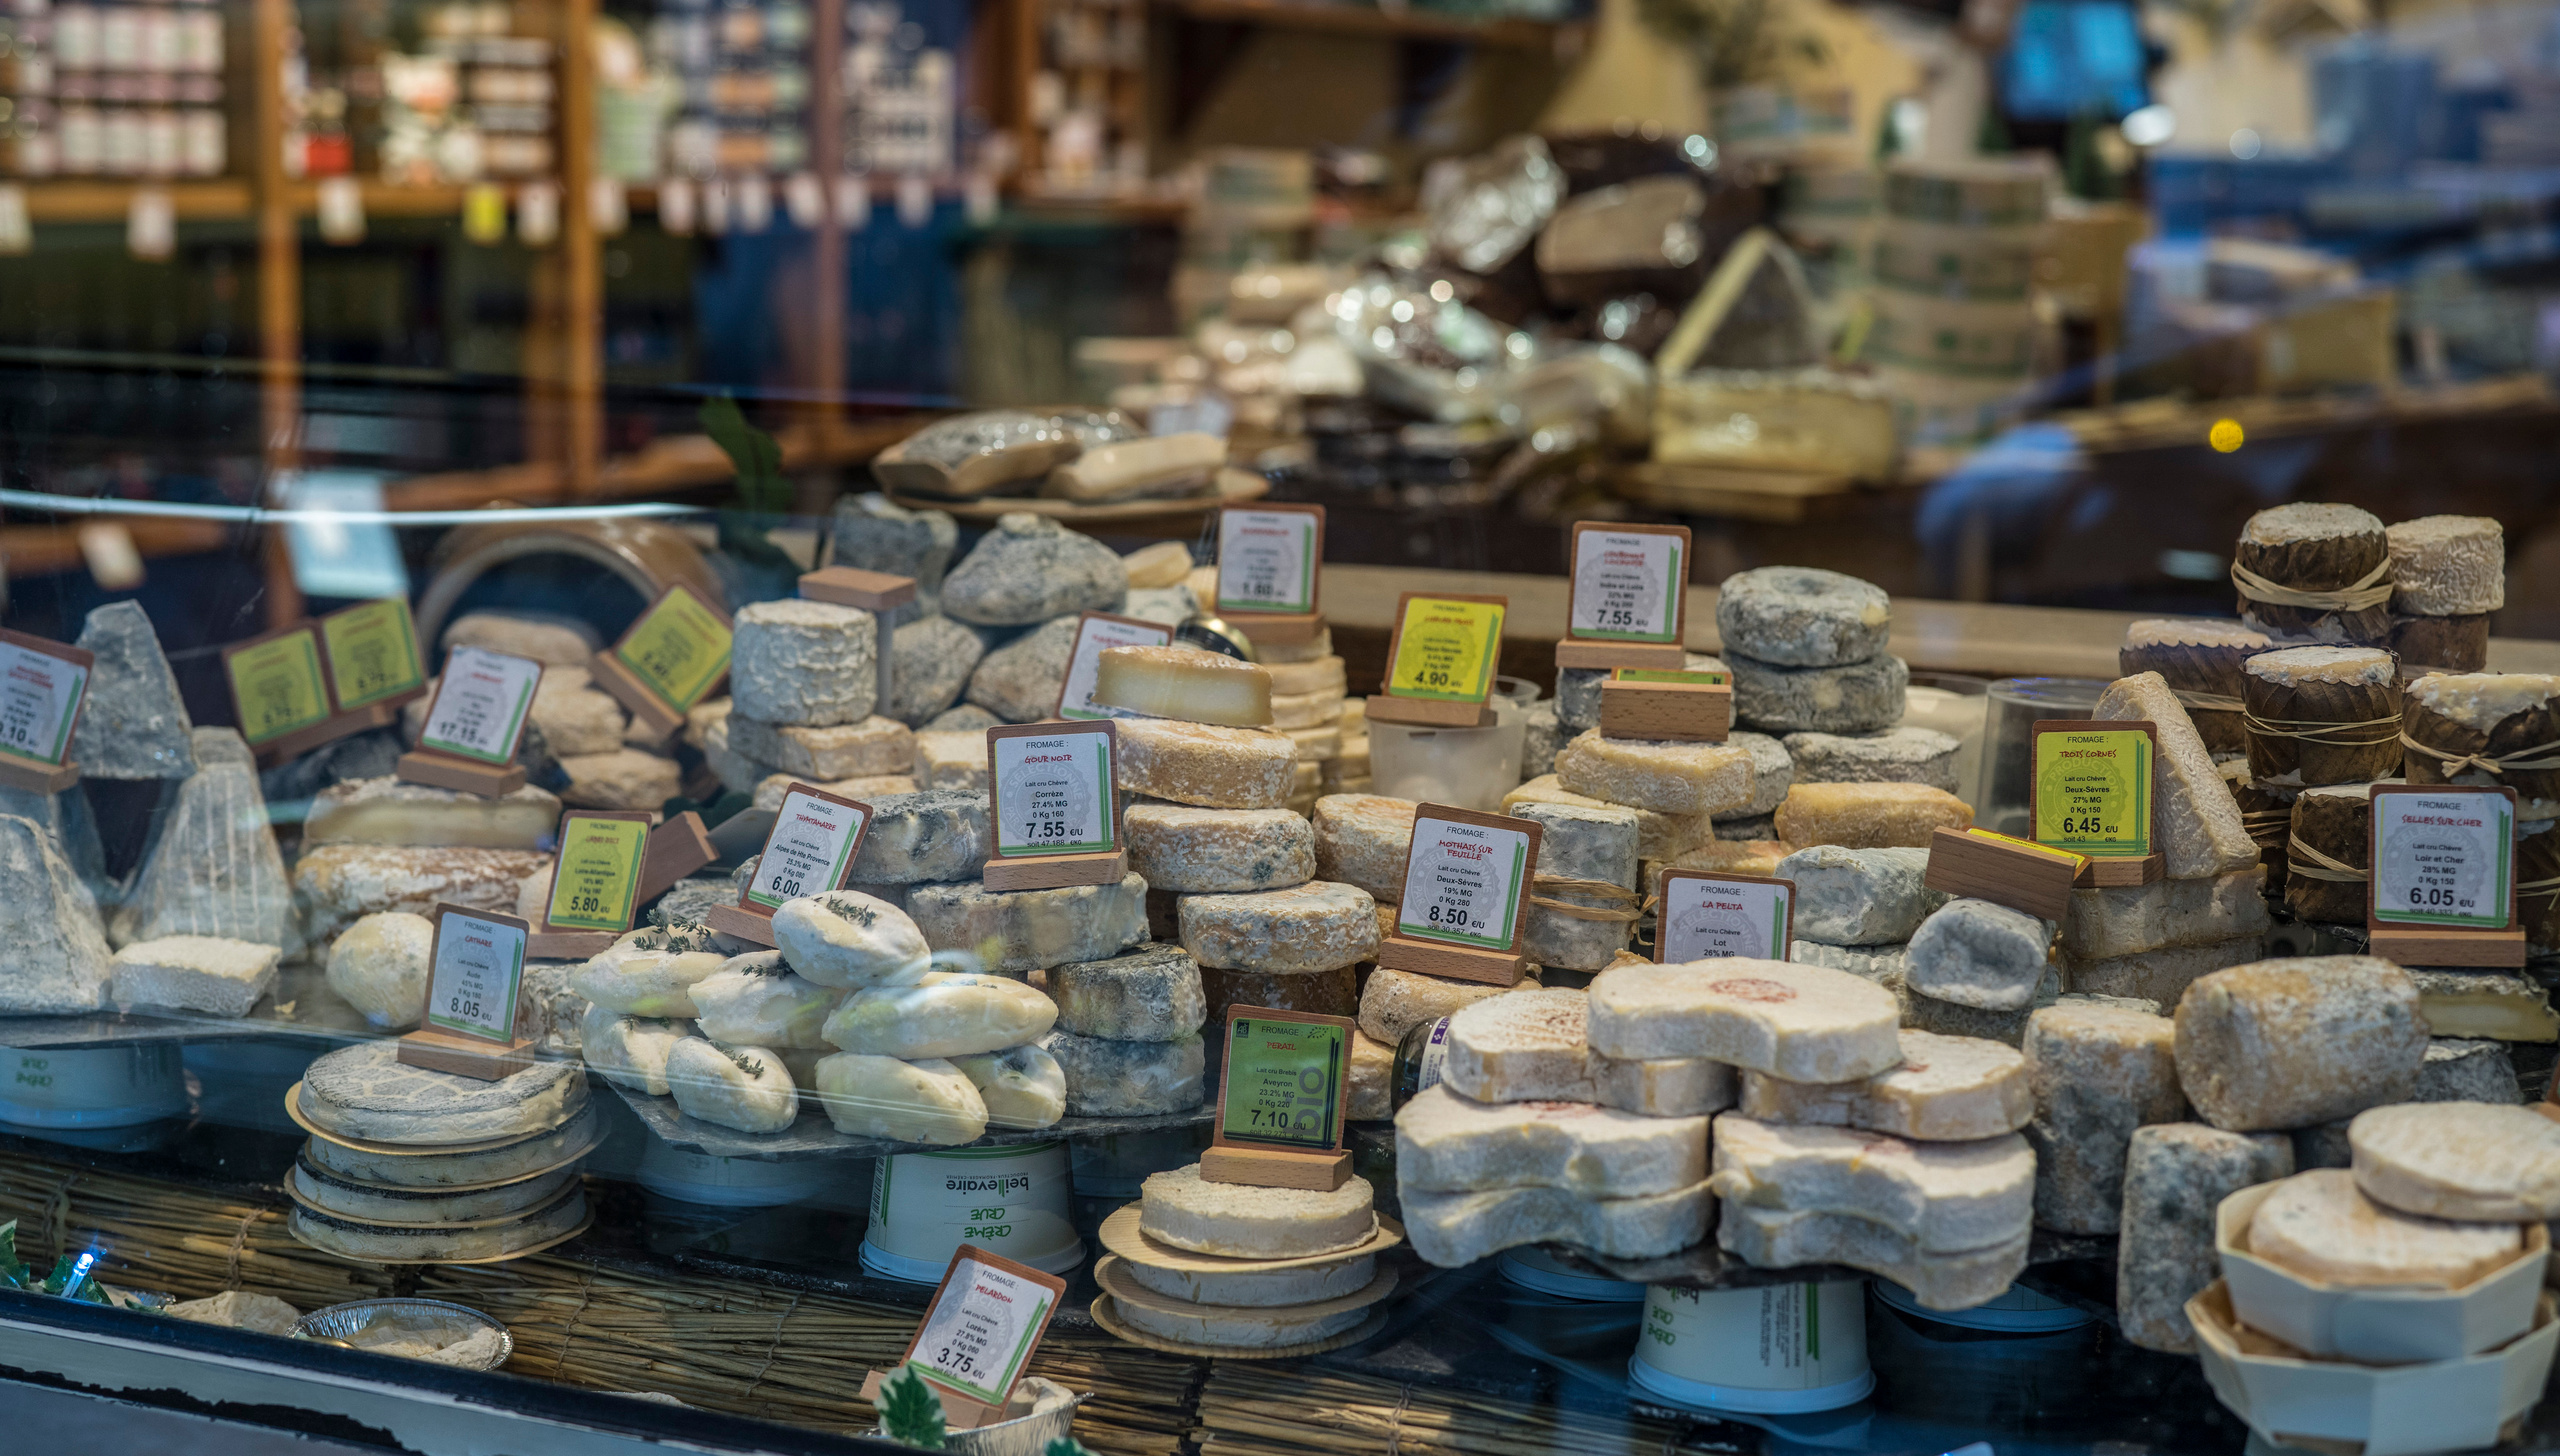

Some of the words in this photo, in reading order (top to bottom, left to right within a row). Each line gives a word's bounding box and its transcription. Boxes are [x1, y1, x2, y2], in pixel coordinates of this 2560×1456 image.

[1606, 538, 1640, 546] FROMAGE
[1597, 610, 1632, 625] 7.55
[1415, 671, 1448, 686] 4.90
[440, 721, 476, 743] 17.15
[2086, 749, 2117, 758] CORNES
[1025, 756, 1049, 764] GOUR
[806, 802, 833, 816] FROMAGE
[2418, 801, 2461, 810] FROMAGE
[796, 814, 836, 831] THYMTAMARRE
[2064, 818, 2100, 833] 6.45
[2402, 814, 2434, 825] SELLES
[2437, 816, 2454, 825] SUR
[2457, 818, 2482, 827] CHER
[1026, 822, 1064, 838] 7.55
[1070, 828, 1083, 836] €/U
[1447, 826, 1484, 838] FROMAGE
[806, 842, 820, 851] Chèvre
[1439, 840, 1476, 852] MOTHAIS
[1478, 843, 1493, 854] SUR
[775, 844, 789, 854] Alpes
[798, 851, 806, 859] Hte
[807, 854, 830, 866] Provence
[1447, 849, 1482, 860] FEUILLE
[2444, 856, 2464, 864] Cher
[787, 858, 802, 868] 25.3%
[802, 863, 811, 871] MG
[575, 868, 615, 877] Loire-Atlantique
[787, 869, 795, 877] Kg
[795, 871, 805, 879] 080
[1460, 868, 1480, 876] Chèvre
[772, 876, 800, 896] 6.00
[1444, 887, 1458, 895] 19%
[1460, 889, 1472, 897] MG
[1701, 886, 1740, 895] FROMAGE
[1445, 897, 1455, 906] Kg
[1457, 898, 1470, 906] 280
[2410, 888, 2453, 906] 6.05
[2459, 899, 2474, 907] €/U
[571, 896, 599, 912] 5.80
[1702, 901, 1713, 909] LA
[1716, 902, 1743, 910] PELTA
[1429, 906, 1468, 926] 8.50
[1472, 920, 1485, 929] €/U
[465, 921, 492, 934] FROMAGE
[1441, 926, 1465, 935] 30.357
[465, 935, 492, 947] CATHARE
[467, 971, 481, 979] Aude
[462, 979, 473, 988] 45%
[474, 982, 483, 990] MG
[463, 990, 470, 998] Kg
[451, 997, 479, 1017] 8.05
[1262, 1026, 1299, 1036] FROMAGE
[1267, 1042, 1296, 1051] PERAIL
[1263, 1078, 1292, 1087] Aveyron
[1259, 1089, 1280, 1097] 23.2%
[1266, 1100, 1275, 1108] Kg
[1281, 1067, 1324, 1136] bio
[1251, 1110, 1288, 1128] 7.10
[1264, 1130, 1287, 1139] 32.273
[946, 1177, 1028, 1198] beillevaire
[971, 1208, 1005, 1220] CRUE
[964, 1225, 1011, 1240] CRÈME
[982, 1270, 1016, 1289] FROMAGE
[975, 1284, 1013, 1304] PELARDON
[962, 1308, 971, 1316] Lait
[981, 1314, 998, 1326] Chèvre
[966, 1321, 987, 1334] Lozère
[956, 1329, 975, 1342] 27.8%
[976, 1337, 988, 1346] MG
[957, 1341, 966, 1351] Kg
[967, 1345, 980, 1354] 060
[937, 1347, 974, 1373] 3.75
[972, 1369, 986, 1379] €/U
[944, 1369, 957, 1379] 62.5
